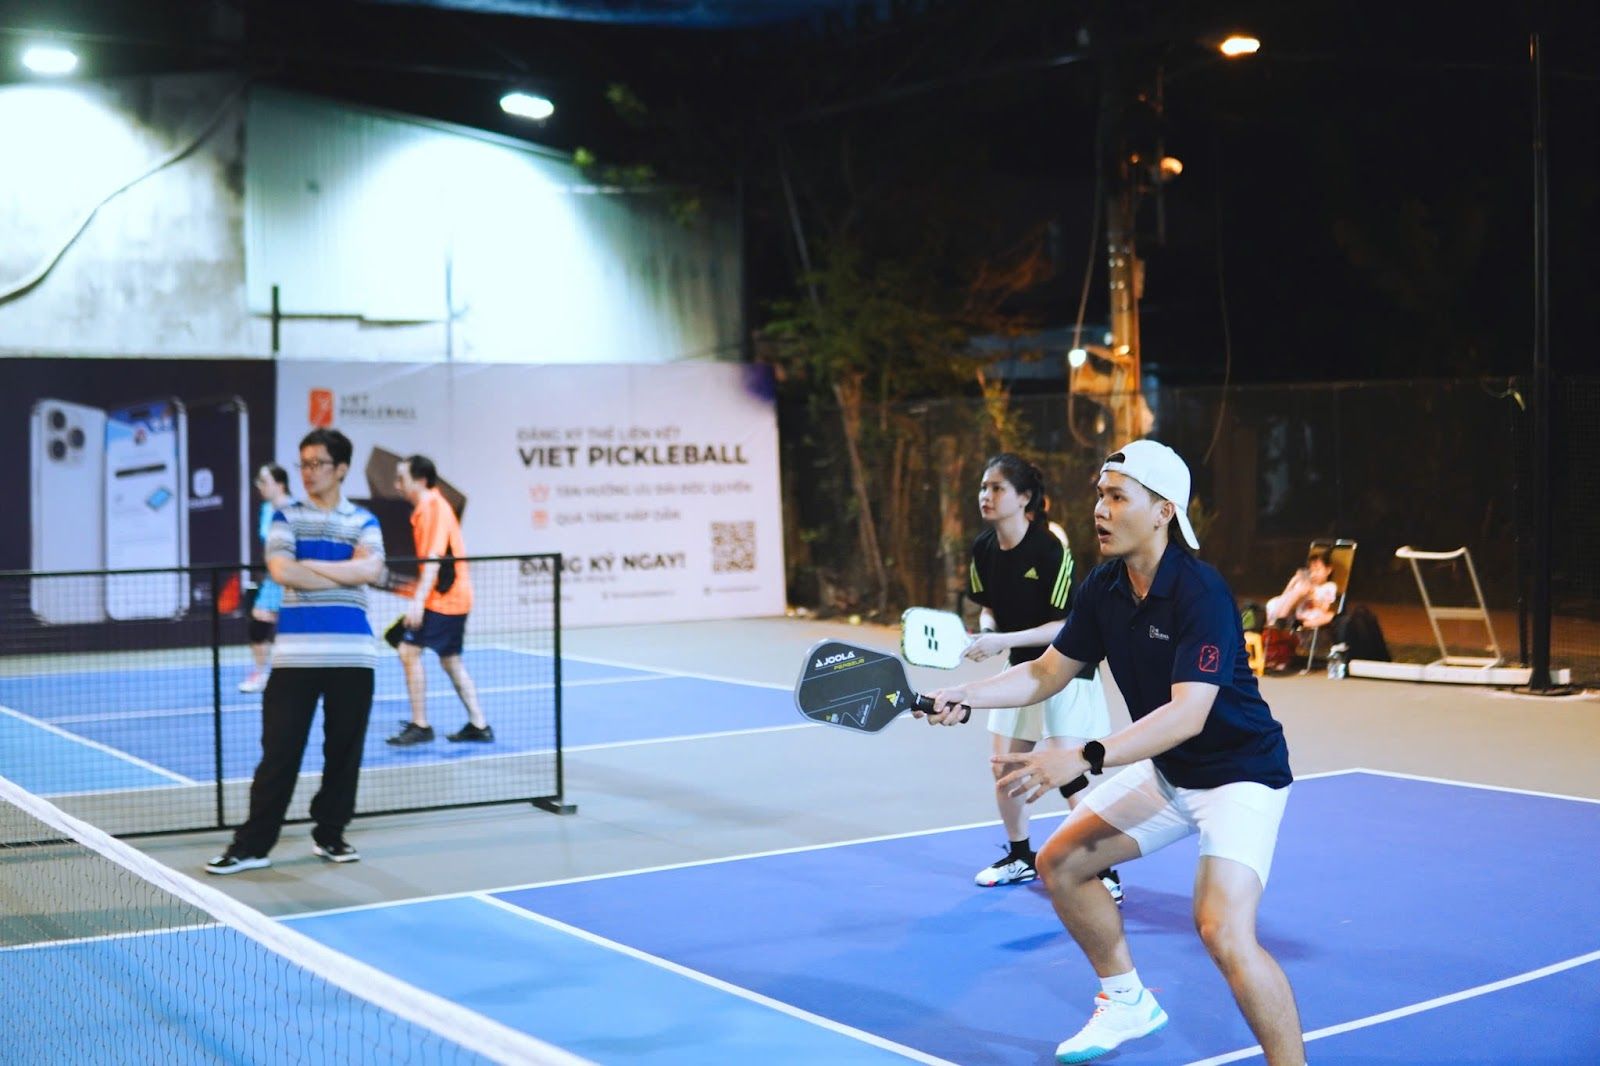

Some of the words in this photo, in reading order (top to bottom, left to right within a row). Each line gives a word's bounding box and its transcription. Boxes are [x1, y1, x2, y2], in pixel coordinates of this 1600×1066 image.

[518, 446, 578, 468] VIET
[587, 444, 749, 467] PICKLEBALL
[823, 651, 856, 666] JOOLA
